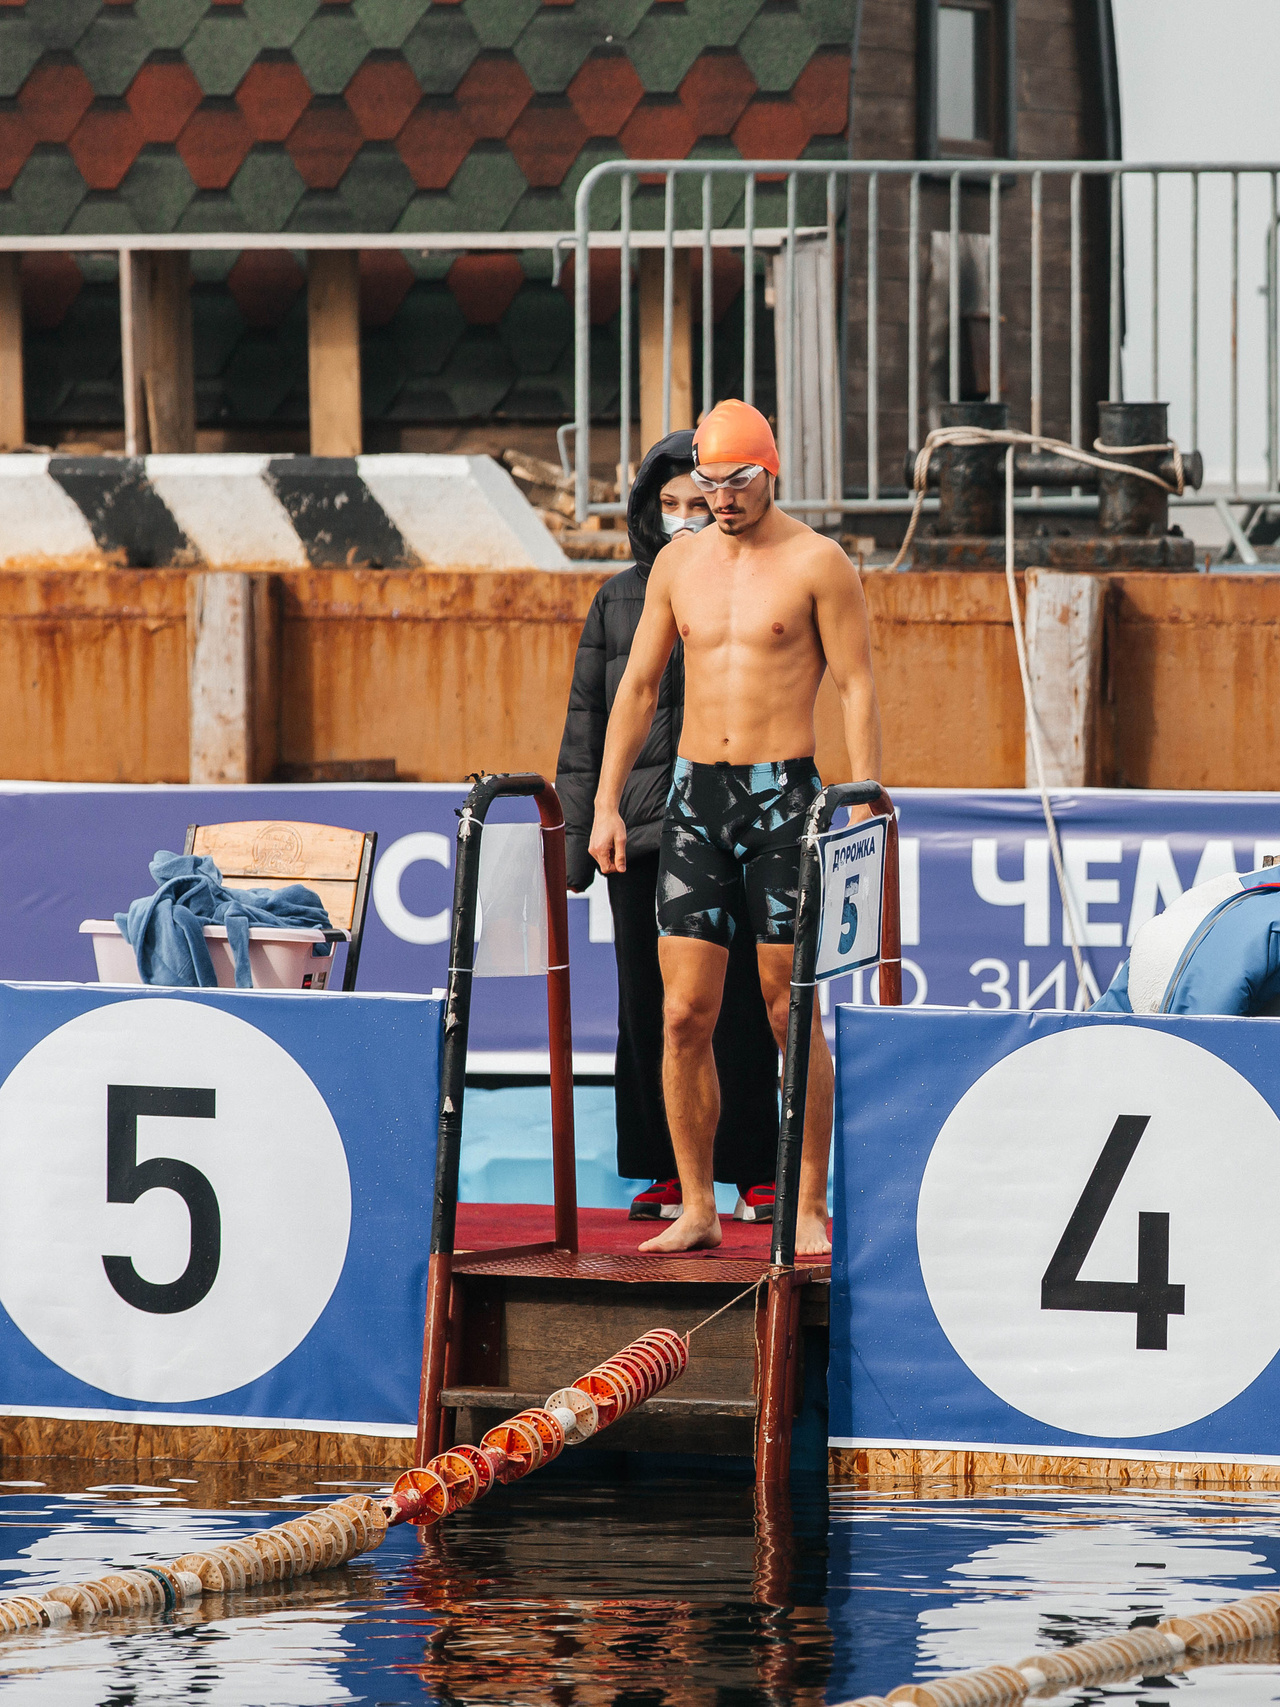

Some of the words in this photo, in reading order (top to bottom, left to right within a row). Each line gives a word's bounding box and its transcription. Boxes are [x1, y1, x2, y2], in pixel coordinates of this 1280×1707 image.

[832, 835, 876, 873] ДОРОЖКА
[837, 873, 860, 955] 5
[101, 1084, 221, 1315] 5
[1040, 1114, 1186, 1351] 4
